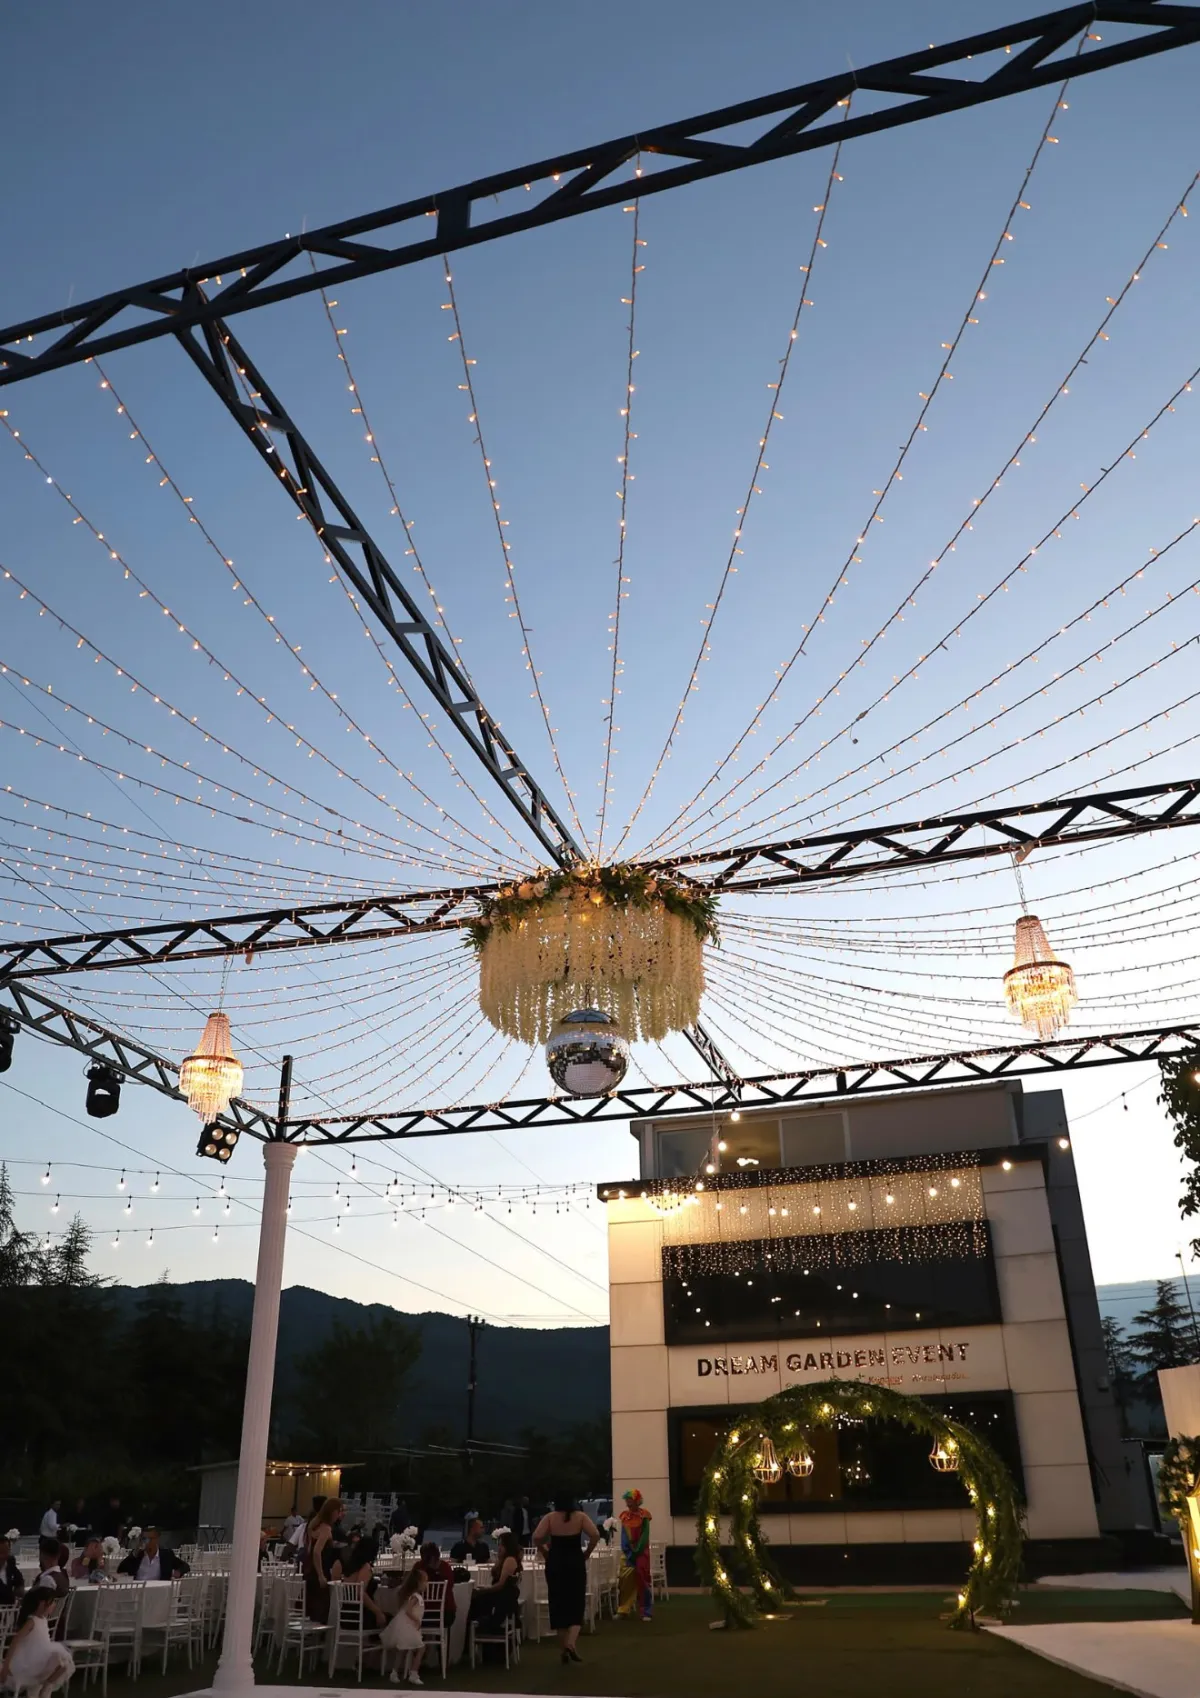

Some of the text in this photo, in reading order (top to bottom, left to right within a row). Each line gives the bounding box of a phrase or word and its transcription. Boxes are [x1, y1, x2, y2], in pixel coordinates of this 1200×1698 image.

[697, 1342, 969, 1376] DREAM GARDEN EVENT
